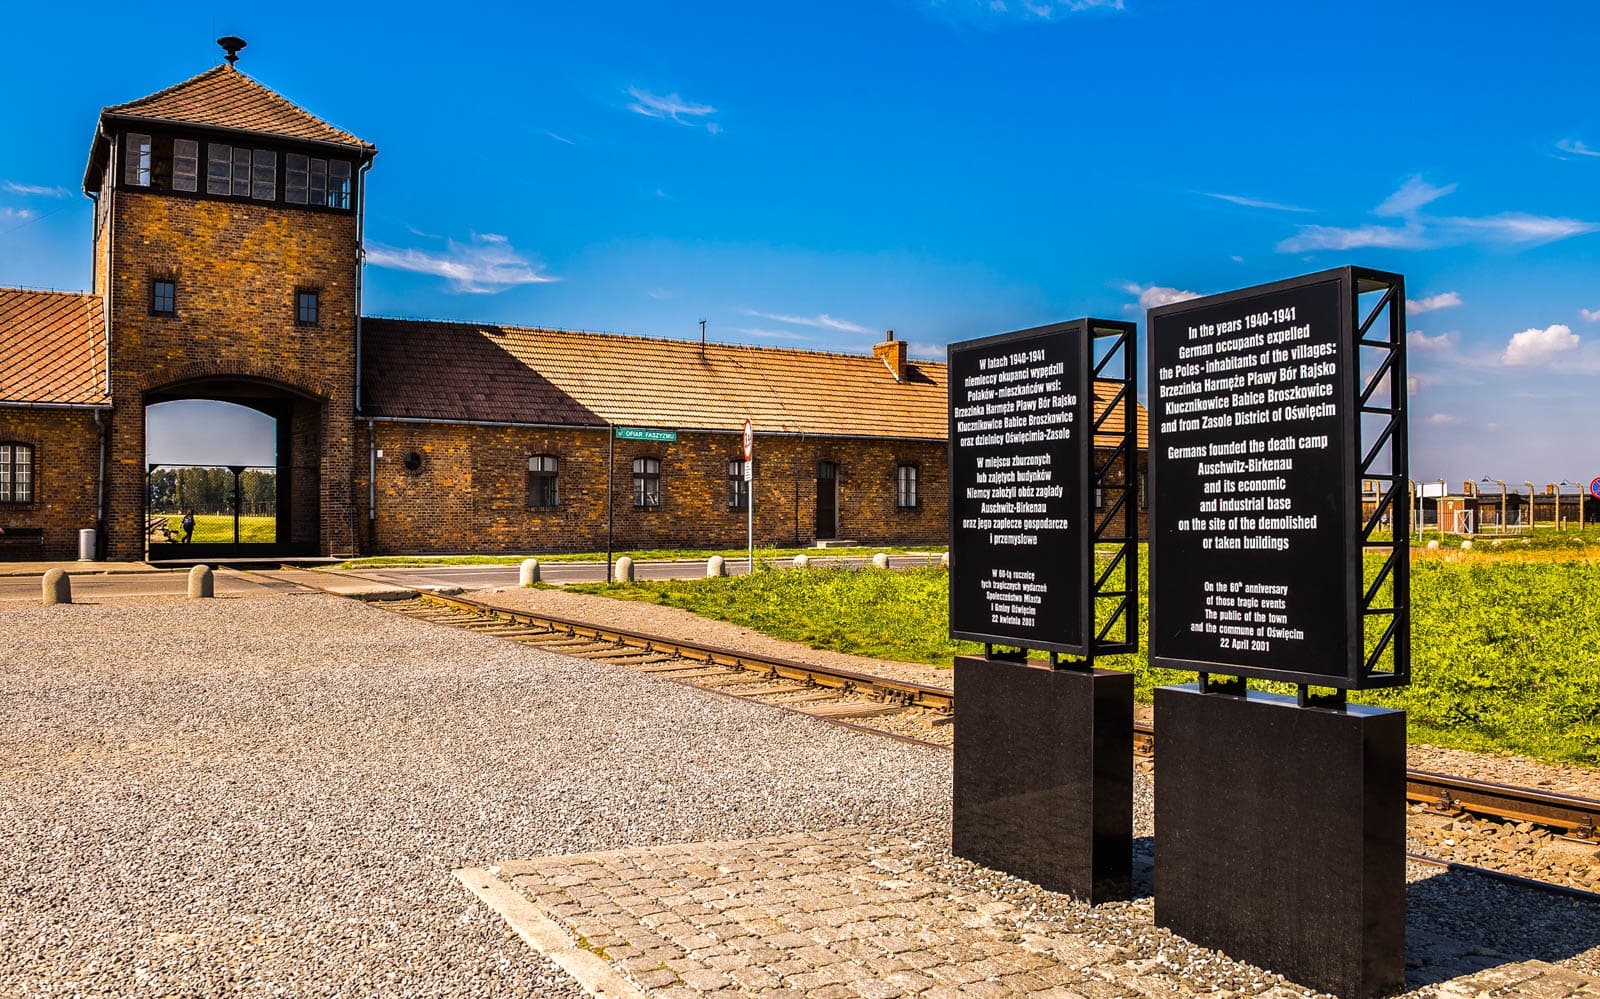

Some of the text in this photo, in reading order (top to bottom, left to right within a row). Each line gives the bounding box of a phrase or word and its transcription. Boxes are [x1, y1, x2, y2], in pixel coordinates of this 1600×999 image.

[1189, 307, 1296, 339] In the years 1940-1941
[1179, 324, 1310, 359] German occupants expelled
[980, 349, 1045, 370] W latach 1940-1941
[1160, 367, 1173, 380] the
[1175, 364, 1200, 377] Poles
[1206, 354, 1257, 373] inhabitants
[1260, 352, 1270, 364] of
[1272, 349, 1288, 362] the
[1291, 342, 1337, 360] villages:
[965, 363, 1063, 387] niemieccy okupanci wypędzili
[1160, 382, 1202, 398] Brzezinka
[1204, 375, 1245, 392] Harmęże
[1279, 367, 1297, 381] Bór
[1300, 361, 1335, 379] Rajsko
[967, 389, 994, 401] Polaków
[999, 383, 1043, 398] mieszkańców
[1046, 380, 1061, 392] wsi:
[1232, 391, 1264, 407] Babice
[1267, 383, 1332, 403] Broszkowice
[955, 405, 984, 417] Brzezinka
[986, 402, 1014, 416] Harmęże
[1039, 398, 1050, 409] Bór
[1052, 394, 1076, 408] Rajsko
[1004, 415, 1027, 427] Babice
[1029, 411, 1073, 426] Broszkowice
[1161, 403, 1336, 433] and from Zasole District of Oświęcim
[960, 428, 1070, 446] oraz dzielnicy Oświęcimia-Zasole
[1168, 434, 1328, 459] Germans founded the death camp
[977, 453, 1051, 468] W miejscu zburzonych
[1198, 458, 1292, 475] Auschwitz-Birkenau
[977, 470, 1051, 484] lub zajętych budynków
[967, 488, 990, 500] Niemcy
[1018, 486, 1034, 497] obóz
[1036, 485, 1063, 498] zagłady
[1204, 477, 1286, 493] and its economic
[981, 502, 1046, 513] Auschwitz-Birkenau
[1200, 497, 1291, 512] and industrial base
[963, 518, 1067, 530] oraz jego zaplecze gospodarcze
[1178, 515, 1317, 531] on the site of the demolished
[990, 534, 992, 544] i
[1202, 536, 1289, 550] or taken buildings
[992, 569, 998, 577] W
[981, 580, 992, 589] tych
[993, 581, 1021, 591] tragicznych
[1204, 582, 1214, 592] On
[1216, 582, 1228, 592] the
[1245, 584, 1288, 595] anniversary
[1024, 594, 1041, 604] Miasta
[1207, 595, 1285, 608] of those tragic events
[991, 603, 1036, 616] i Gminy Oświęcim
[1205, 609, 1287, 623] The public of the town
[992, 615, 1035, 626] 22 kwietnia 2001
[1191, 623, 1304, 640] and the commune of Oświęcim
[1220, 638, 1269, 651] 22 April 2001
